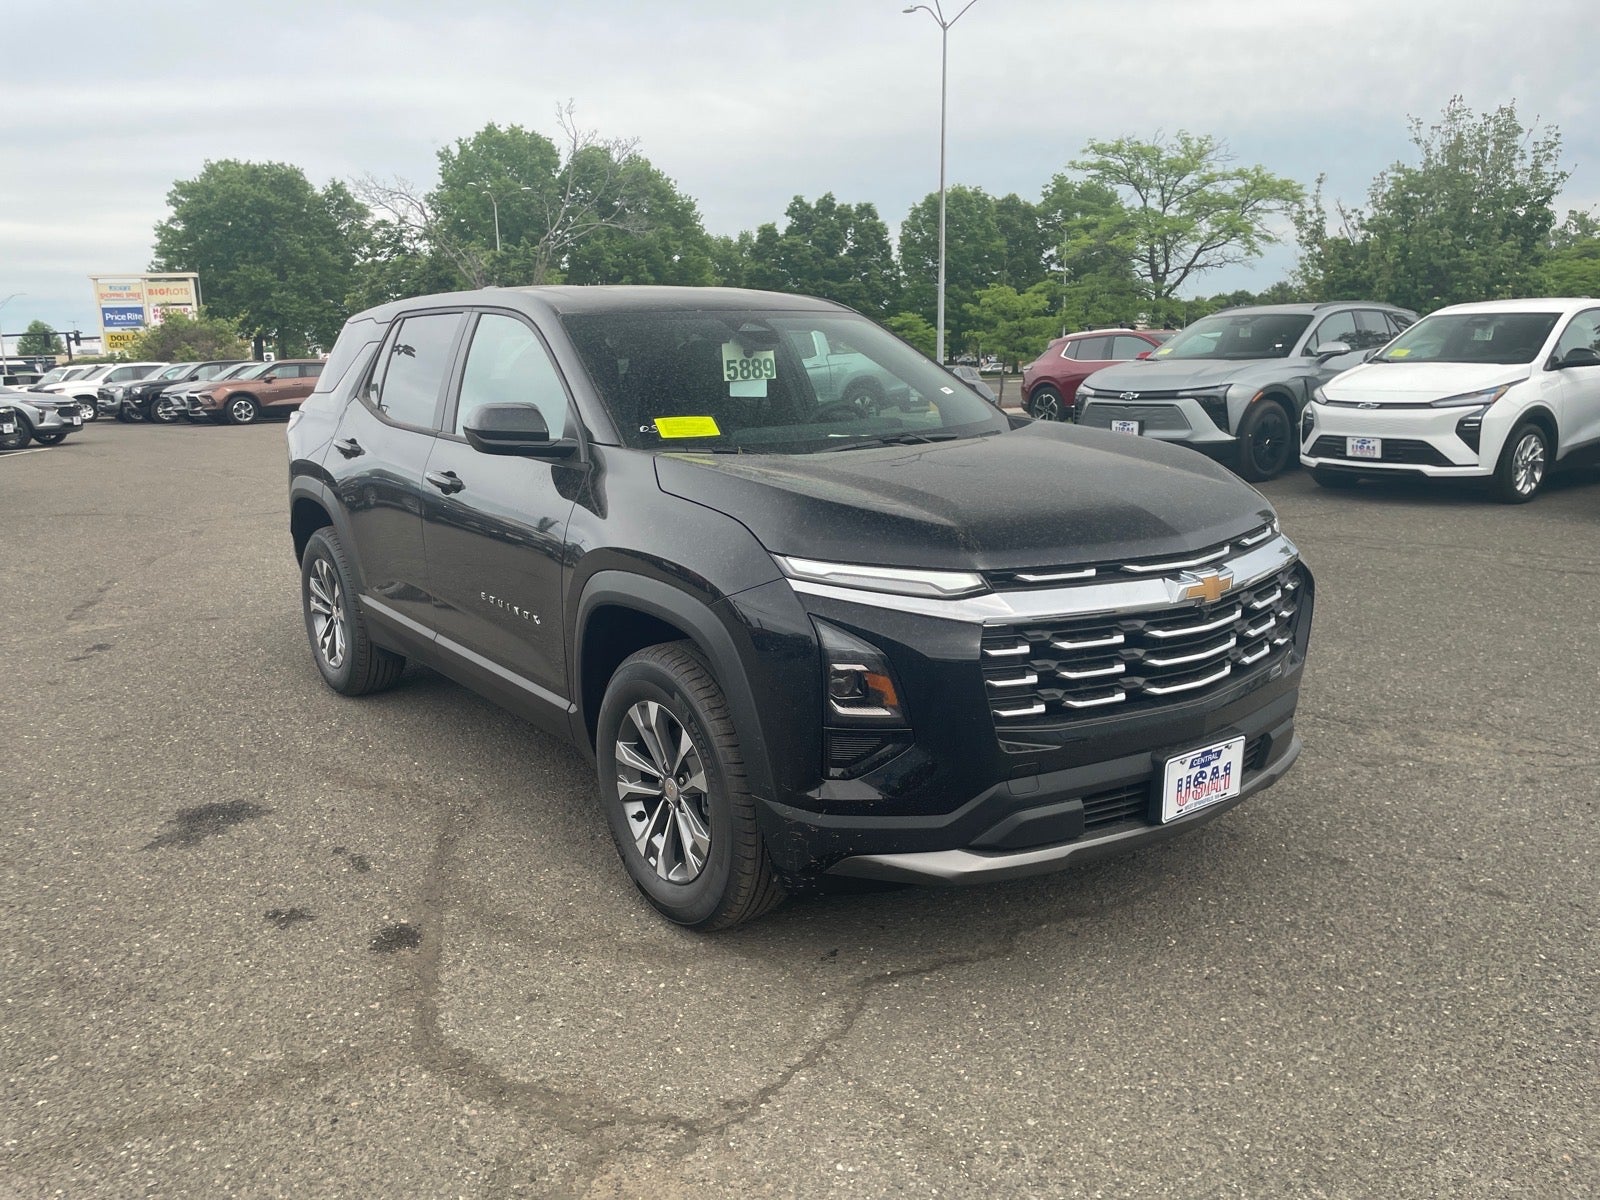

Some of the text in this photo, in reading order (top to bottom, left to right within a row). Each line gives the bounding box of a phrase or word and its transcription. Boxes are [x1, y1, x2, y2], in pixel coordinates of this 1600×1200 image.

[105, 312, 126, 321] Price
[127, 312, 143, 321] Rite
[110, 334, 136, 342] DOLLA
[726, 358, 774, 380] 5889
[480, 591, 541, 625] EQUINOX
[1193, 752, 1219, 765] CENTRAL
